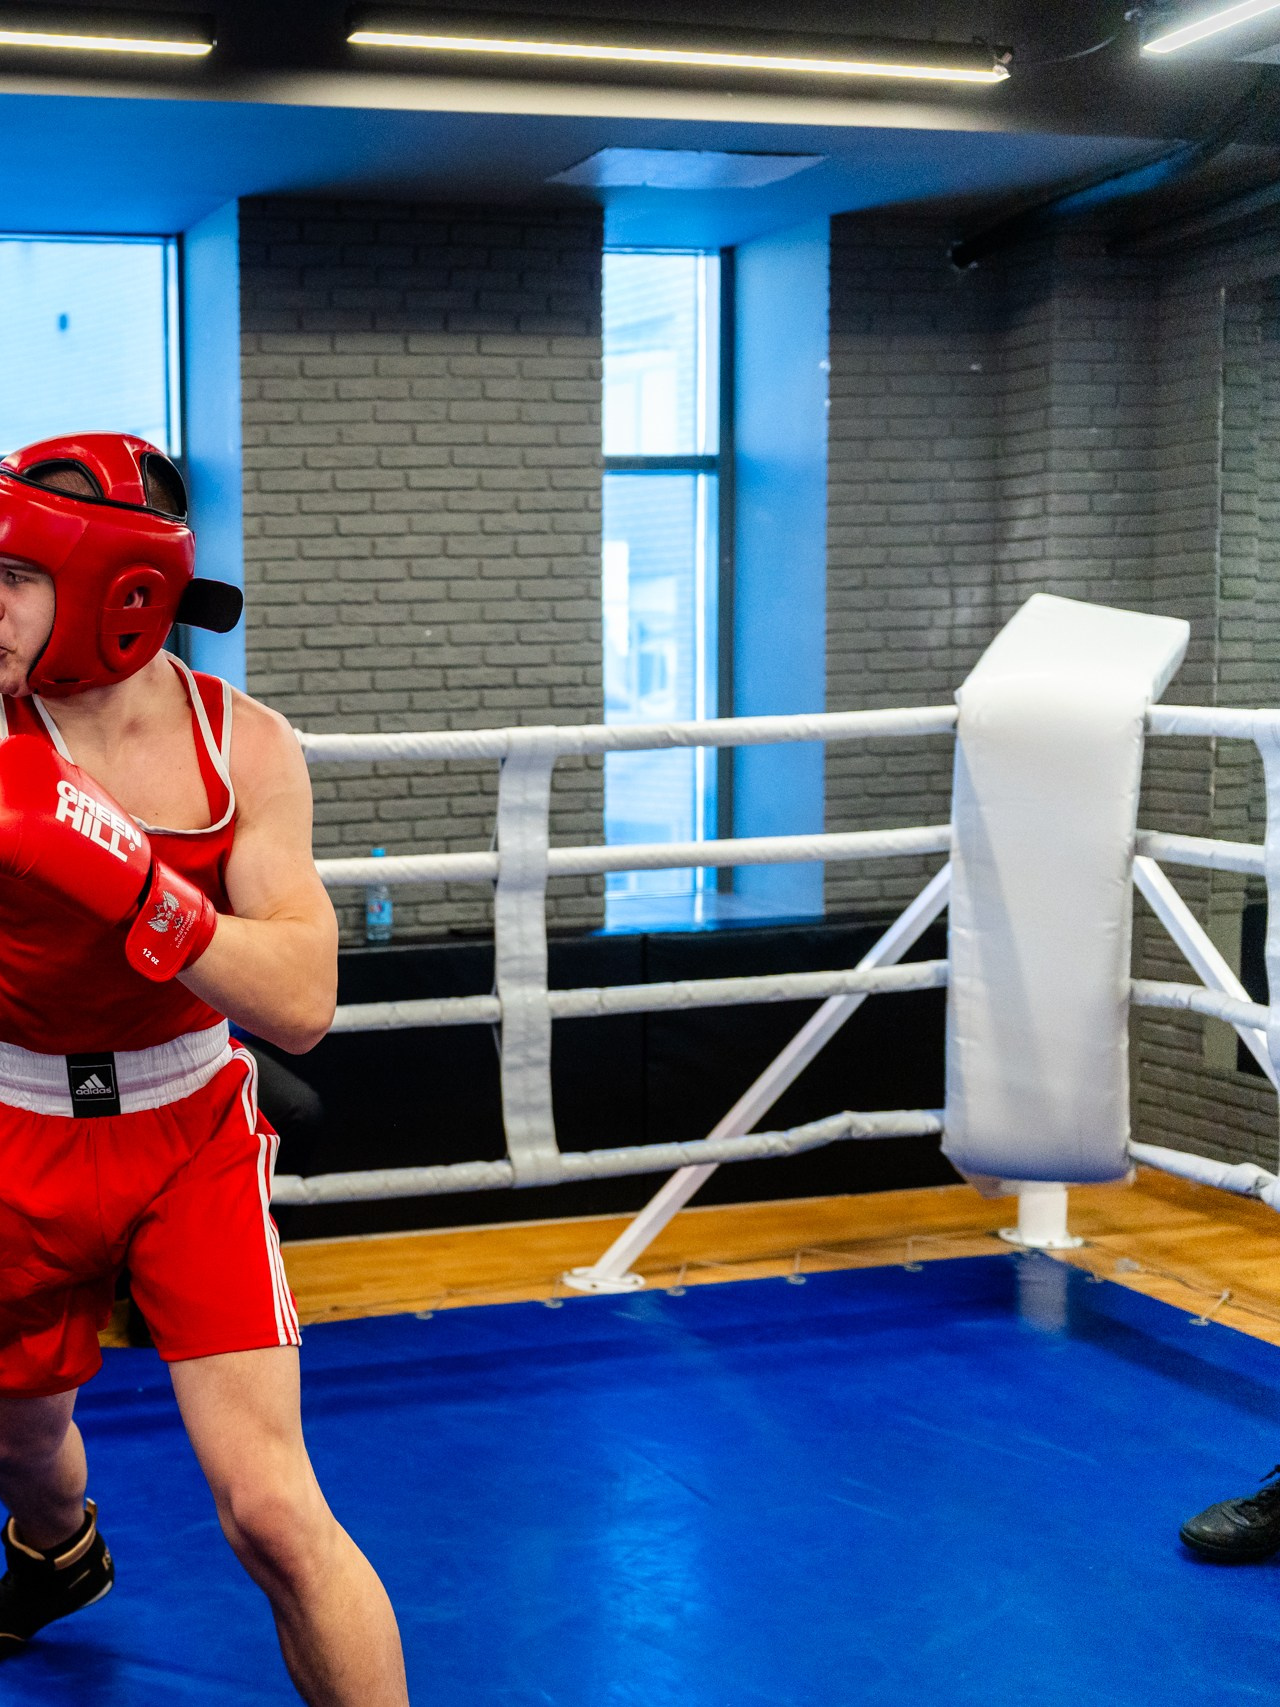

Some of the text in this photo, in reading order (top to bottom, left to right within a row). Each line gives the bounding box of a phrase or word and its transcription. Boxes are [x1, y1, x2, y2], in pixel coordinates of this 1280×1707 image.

[55, 797, 128, 863] HILL
[56, 780, 142, 848] GREEN
[142, 948, 152, 958] 12
[75, 1087, 112, 1095] adidas
